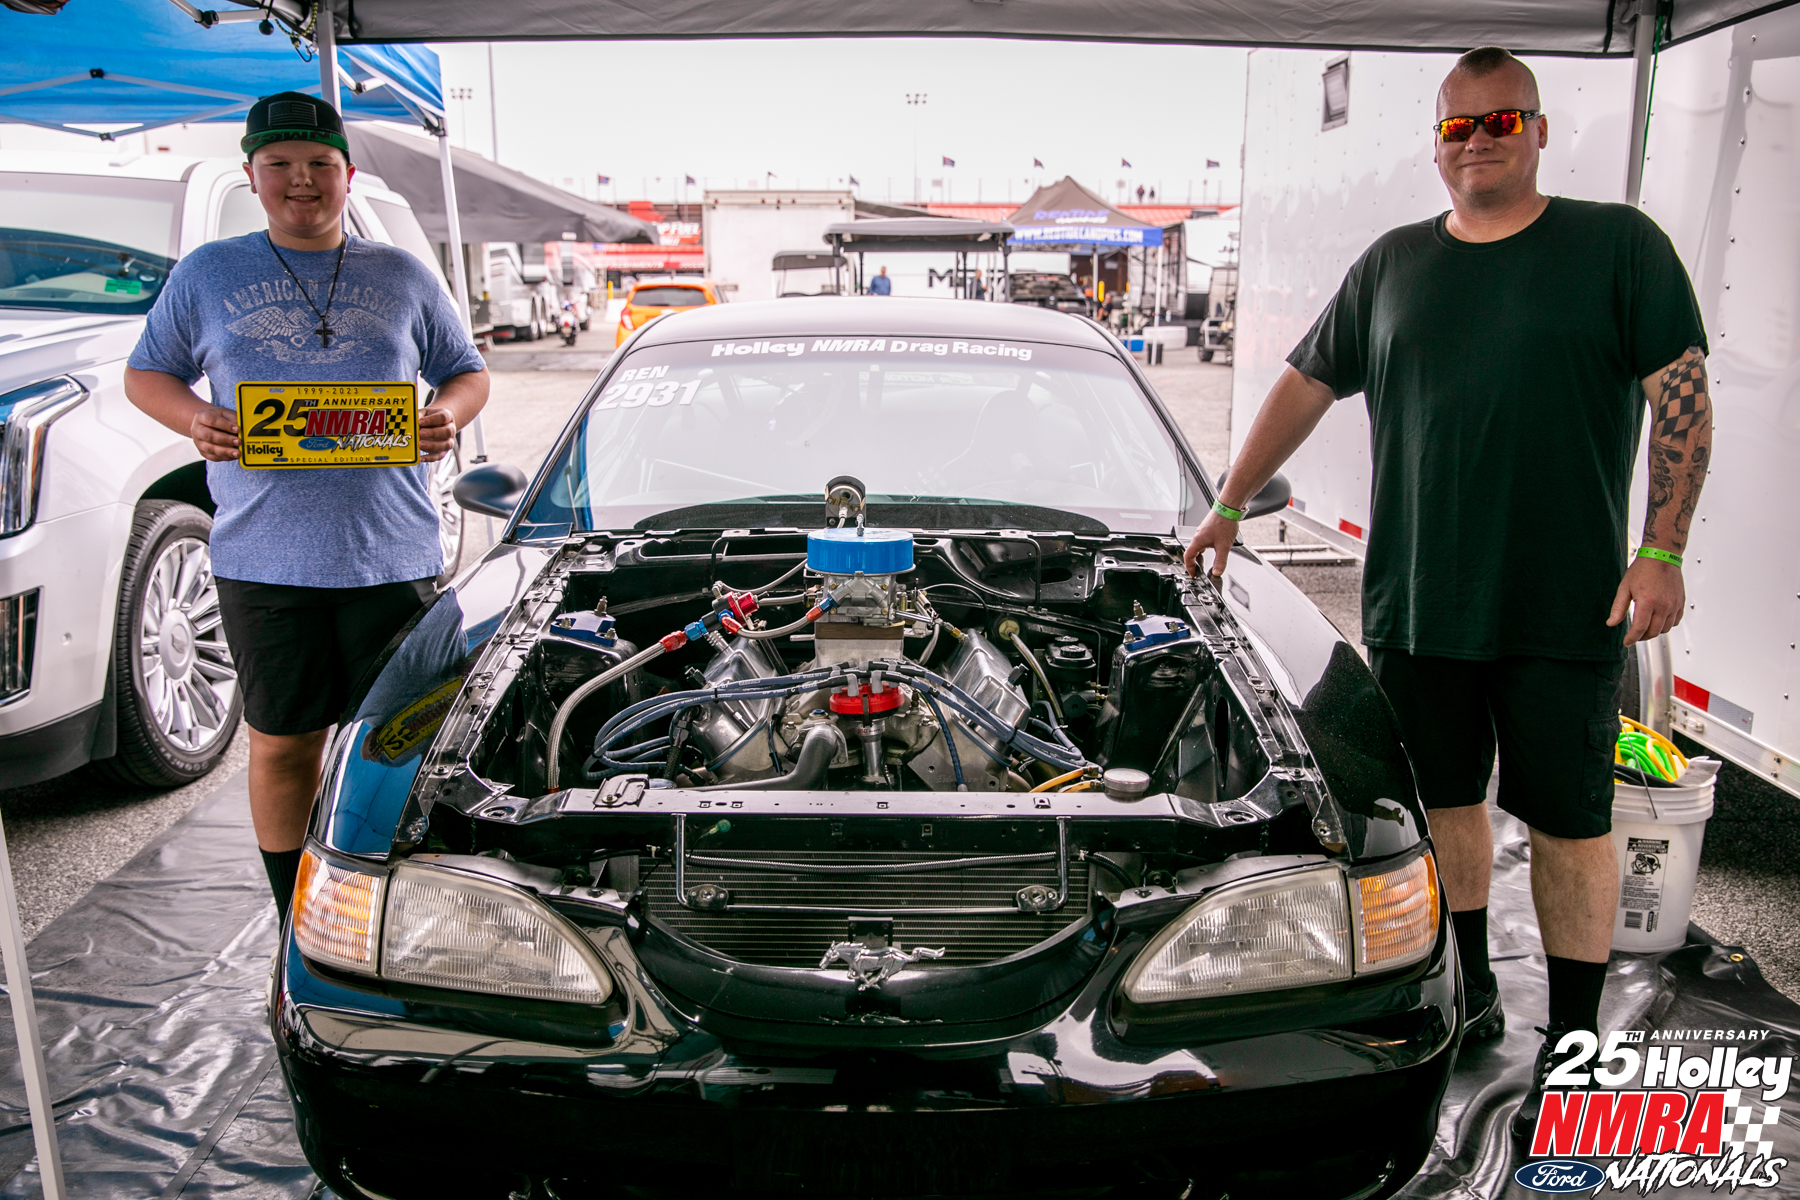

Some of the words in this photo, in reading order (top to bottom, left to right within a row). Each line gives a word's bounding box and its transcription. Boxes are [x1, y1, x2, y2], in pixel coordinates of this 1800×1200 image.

[223, 279, 319, 316] AMERICAN
[711, 341, 805, 357] Holley
[811, 339, 886, 352] NMRA
[889, 340, 948, 355] Drag
[952, 341, 1032, 361] Racing
[619, 365, 670, 383] REN
[297, 387, 359, 395] 1999-2023
[595, 379, 702, 411] 2931
[323, 397, 408, 406] ANNIVERSARY
[304, 409, 386, 436] NMRA
[247, 444, 283, 457] Holley
[331, 433, 412, 453] NATIONALS
